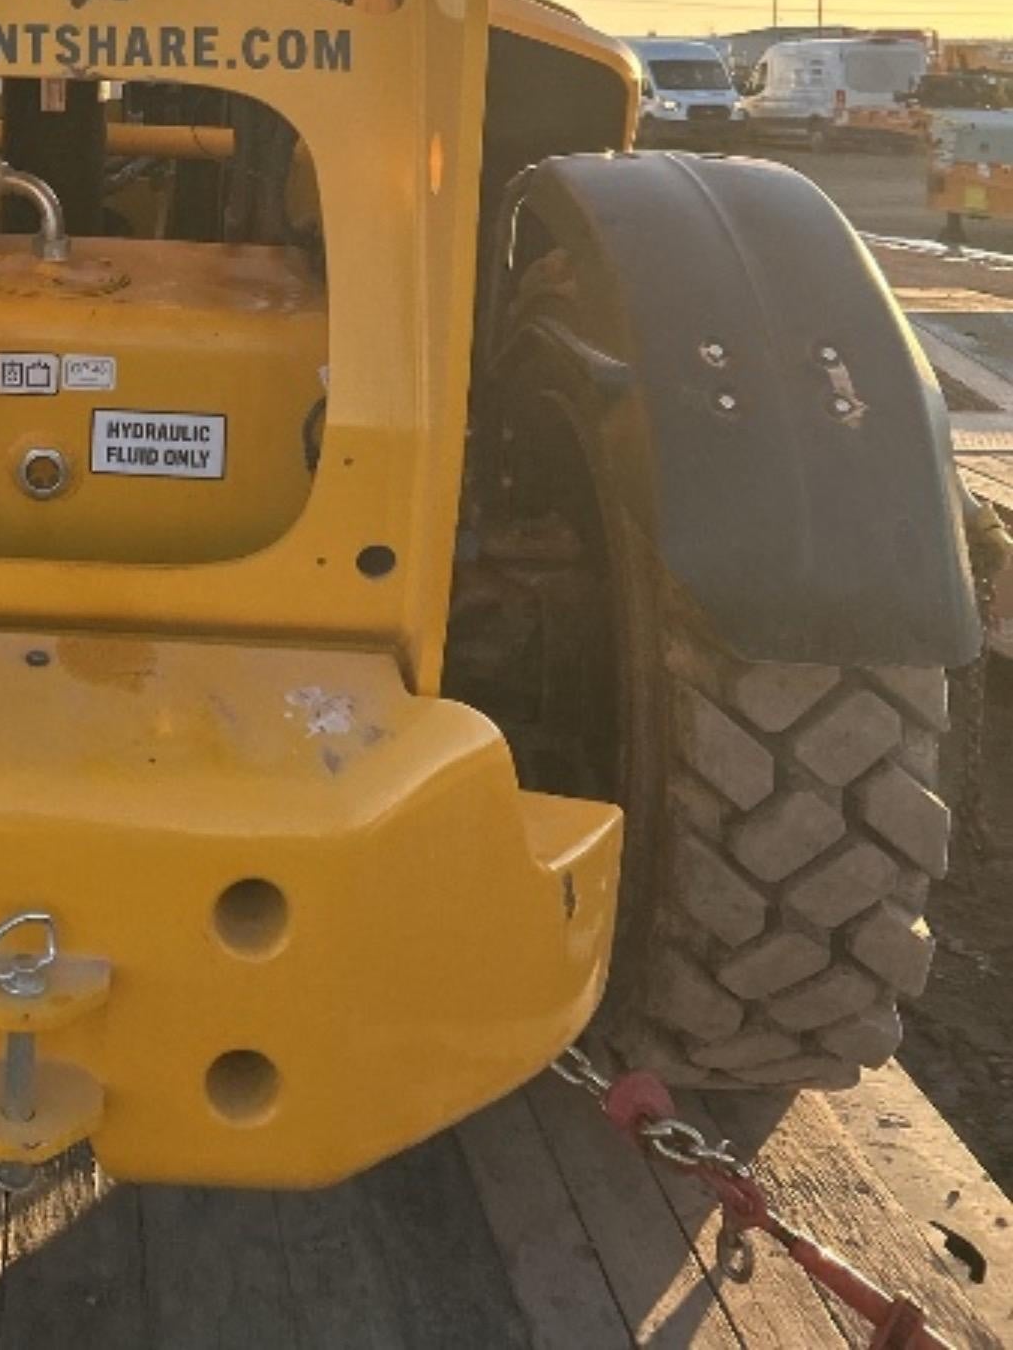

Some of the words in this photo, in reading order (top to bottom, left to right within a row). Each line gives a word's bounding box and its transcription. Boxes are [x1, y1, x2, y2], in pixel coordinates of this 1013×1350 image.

[107, 421, 210, 442] HYDRAULIC
[106, 446, 158, 466] FLUID
[163, 449, 210, 468] ONLY
